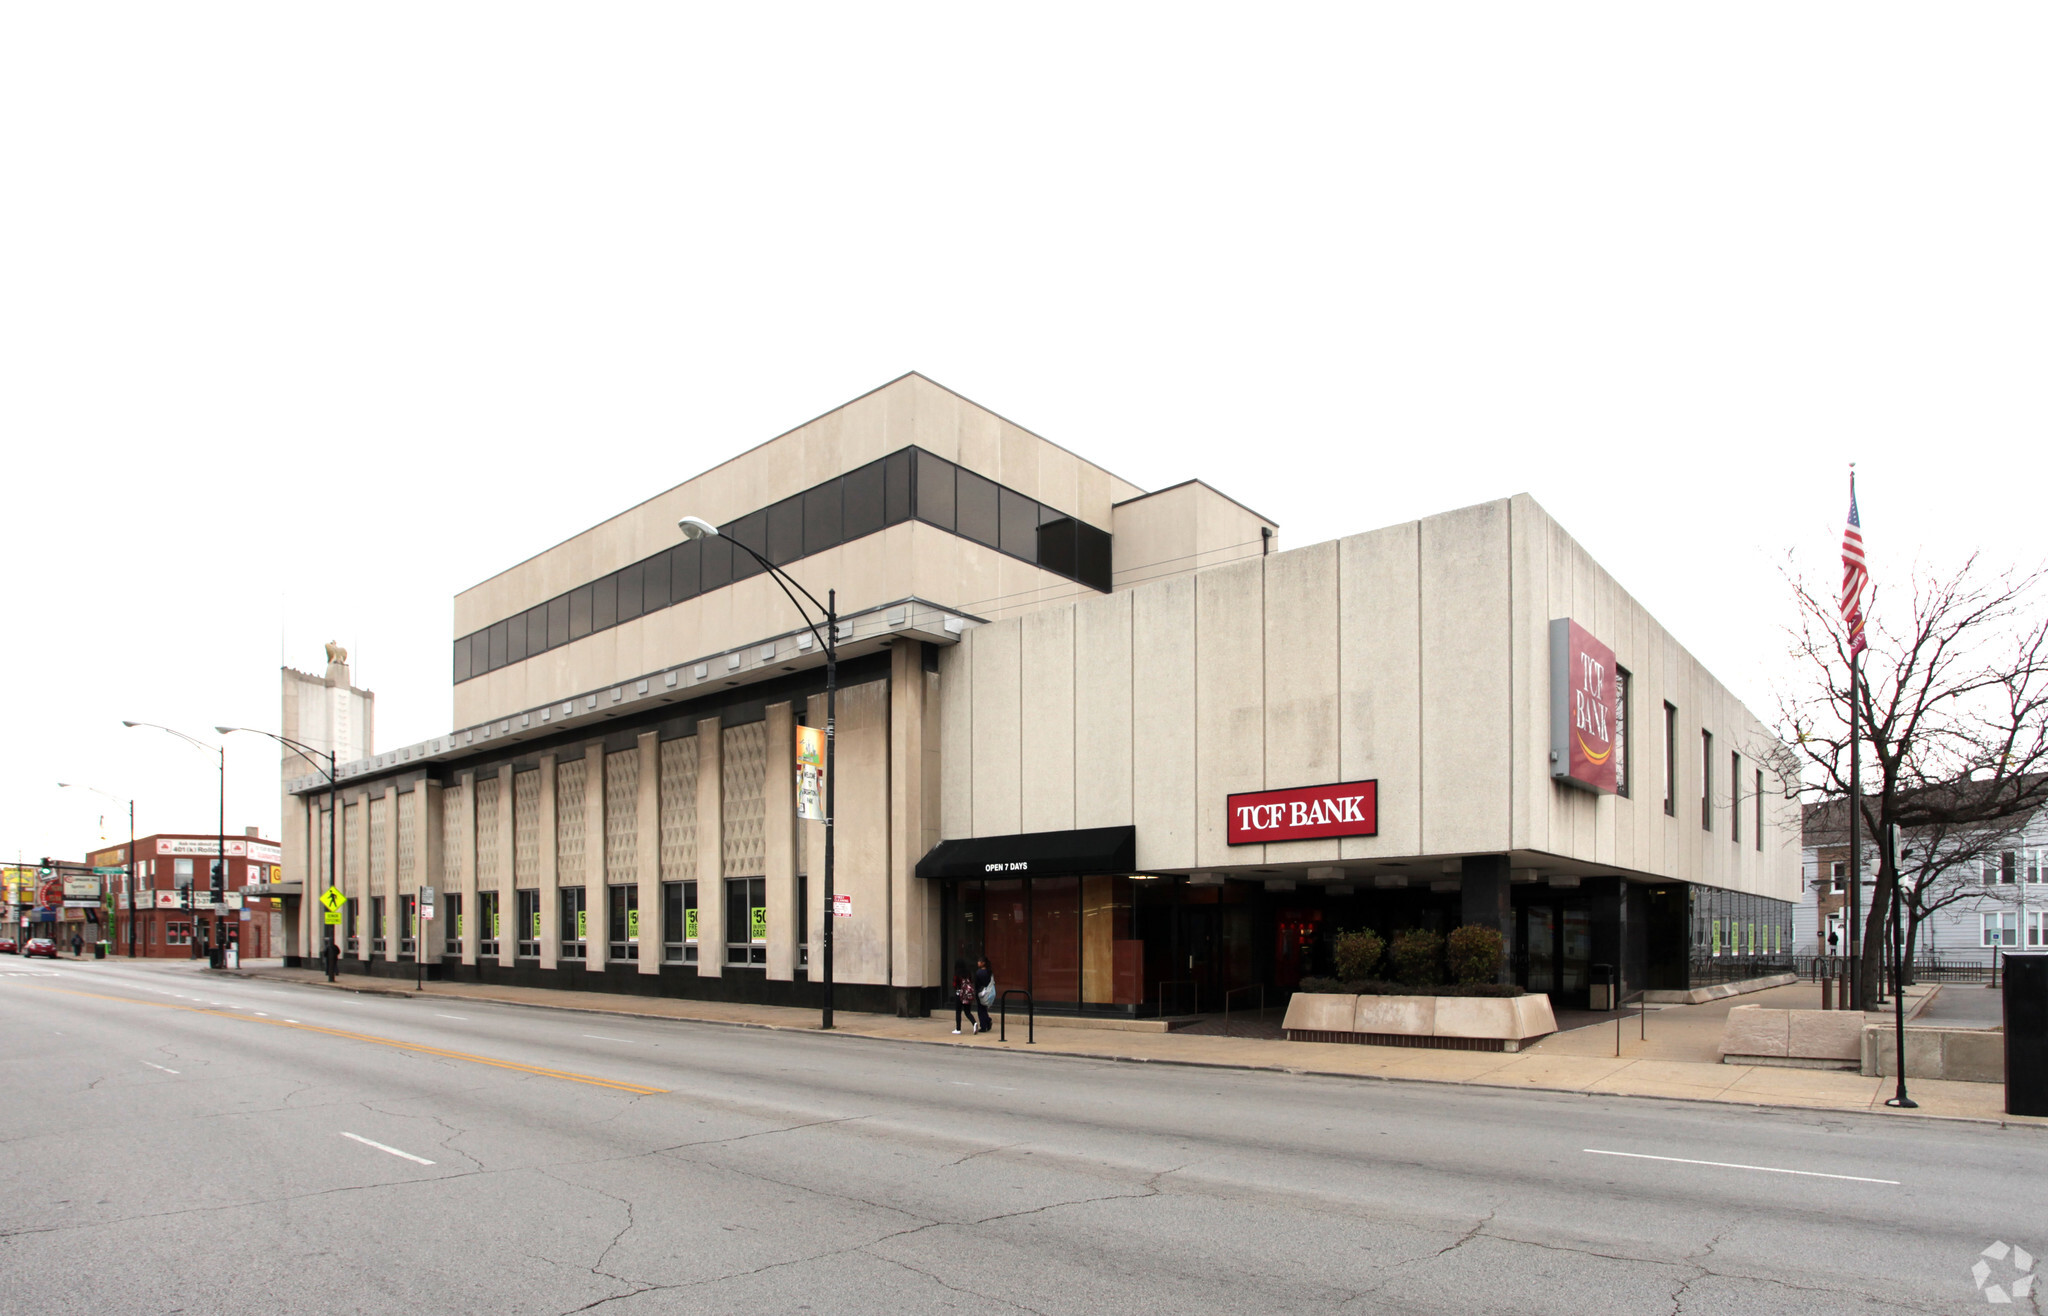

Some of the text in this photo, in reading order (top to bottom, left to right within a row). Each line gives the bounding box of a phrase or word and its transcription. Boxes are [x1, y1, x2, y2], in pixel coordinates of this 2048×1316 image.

[1580, 652, 1605, 700] TCF
[1576, 689, 1609, 743] BANK
[1237, 795, 1366, 831] TCF BANK
[985, 862, 1028, 872] OPEN 7 DAYS
